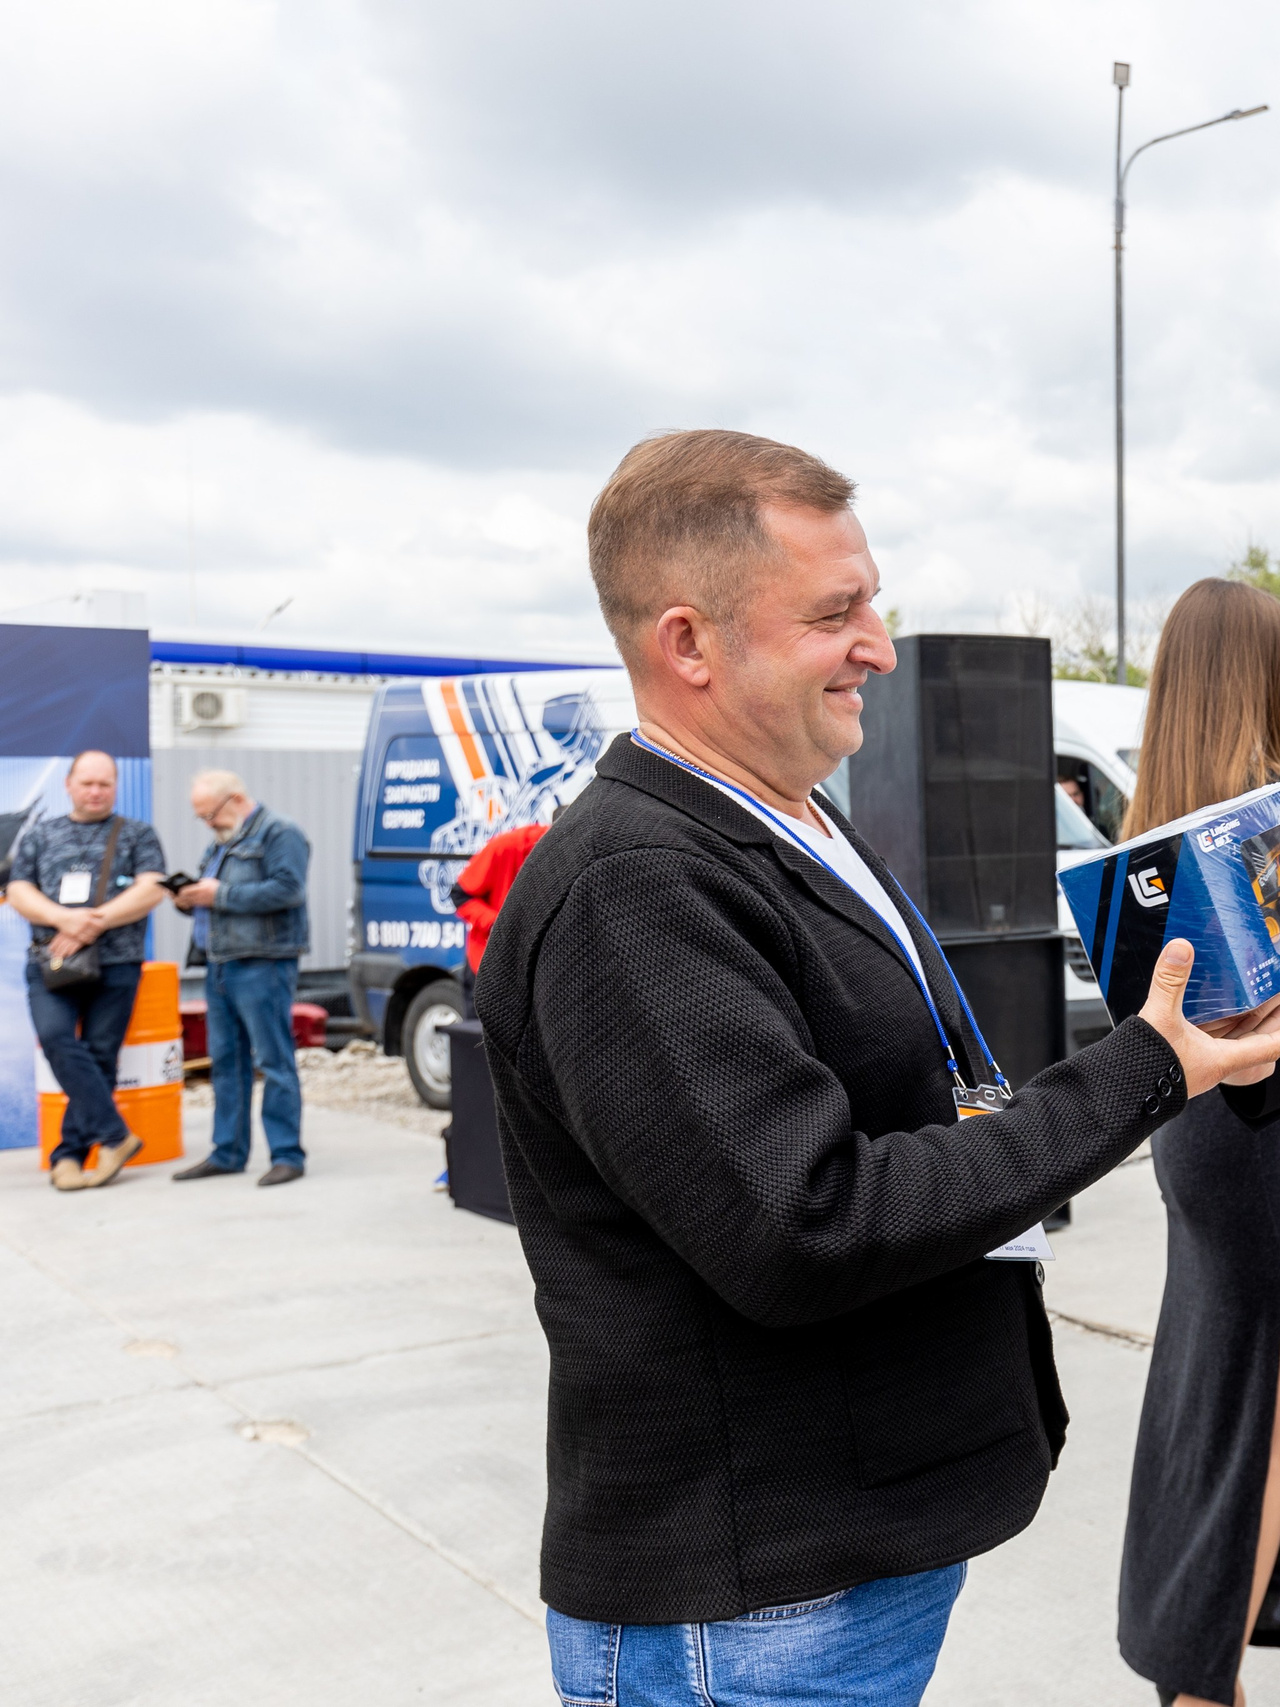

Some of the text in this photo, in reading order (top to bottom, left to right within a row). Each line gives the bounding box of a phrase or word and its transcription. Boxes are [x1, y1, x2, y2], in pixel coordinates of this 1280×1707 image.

[385, 758, 440, 781] ПРОДАЖА
[383, 783, 441, 805] ЗАПЧАСТИ
[382, 808, 425, 829] СЕРВИС
[366, 920, 379, 947] 8
[380, 920, 410, 948] 800
[409, 920, 441, 949] 700
